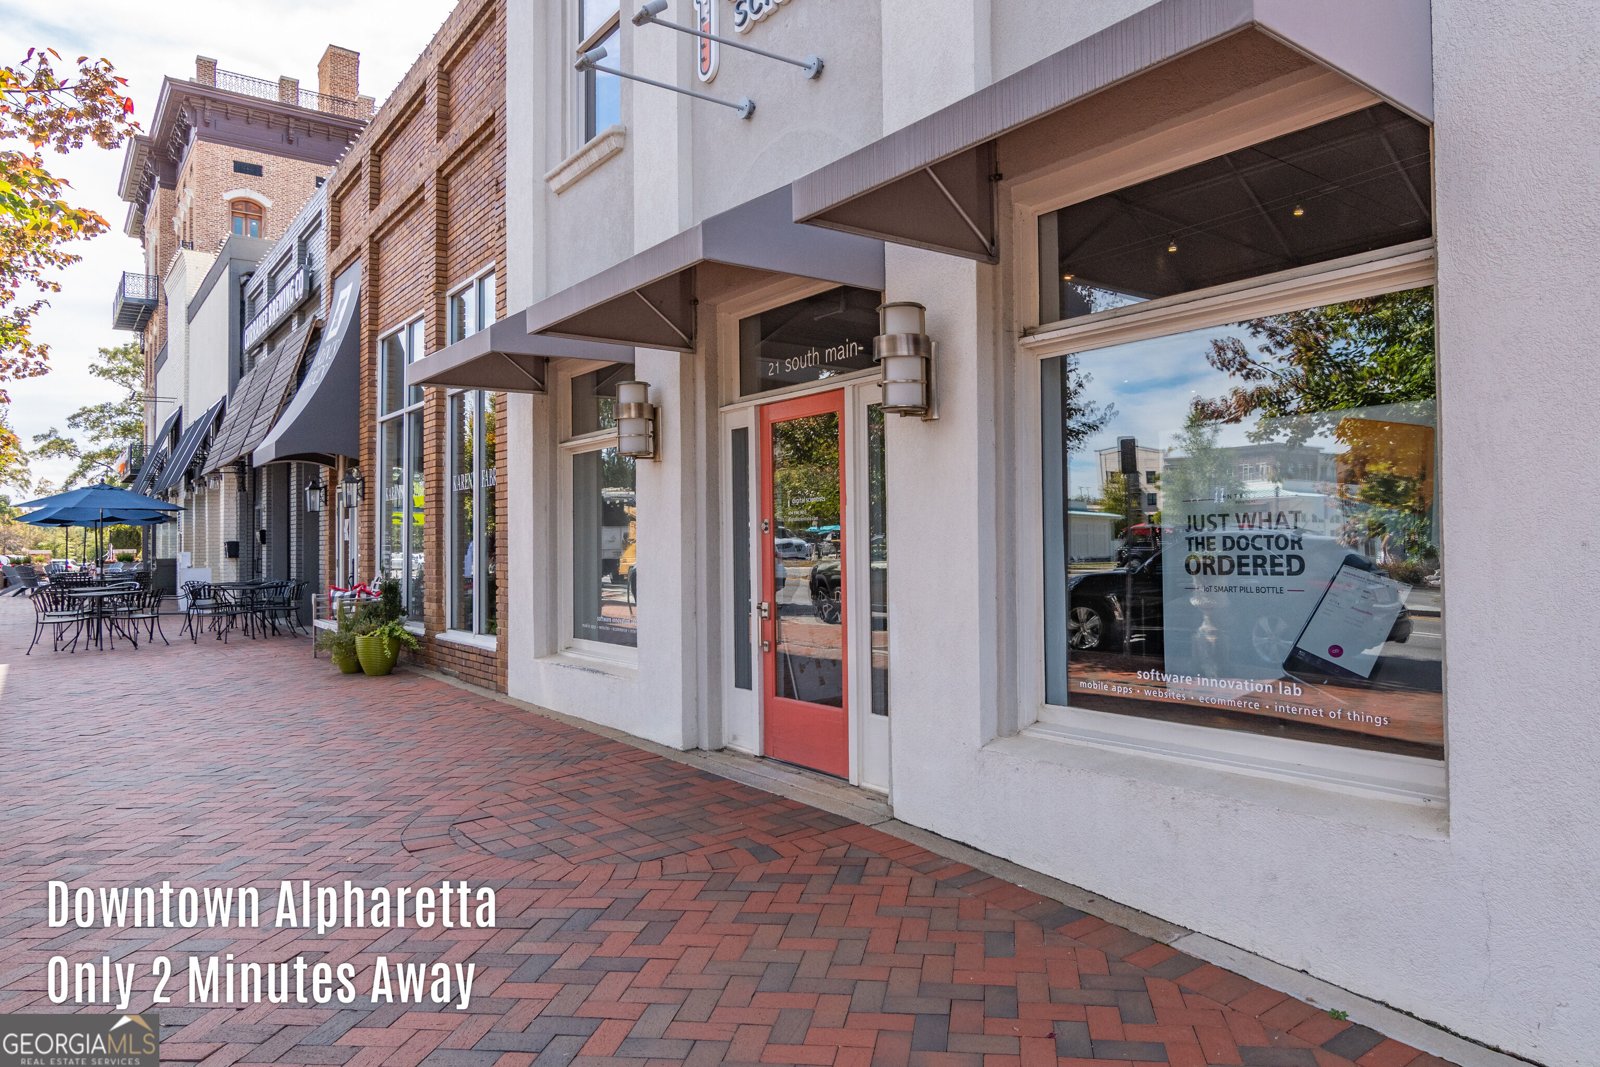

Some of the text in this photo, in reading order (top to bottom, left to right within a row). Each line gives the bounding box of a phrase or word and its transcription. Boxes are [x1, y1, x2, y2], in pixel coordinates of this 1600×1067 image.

[768, 361, 780, 376] 21
[785, 346, 820, 373] south
[1185, 510, 1302, 533] JUST WHAT
[1185, 533, 1304, 552] THE DOCTOR
[1184, 553, 1306, 577] ORDERED
[1213, 585, 1238, 594] SMART
[1239, 586, 1255, 594] PILL
[1255, 586, 1285, 595] BOTTLE
[1136, 669, 1303, 697] software innovation lab
[1079, 680, 1389, 727] mobile apps websites ecommerce internet of things
